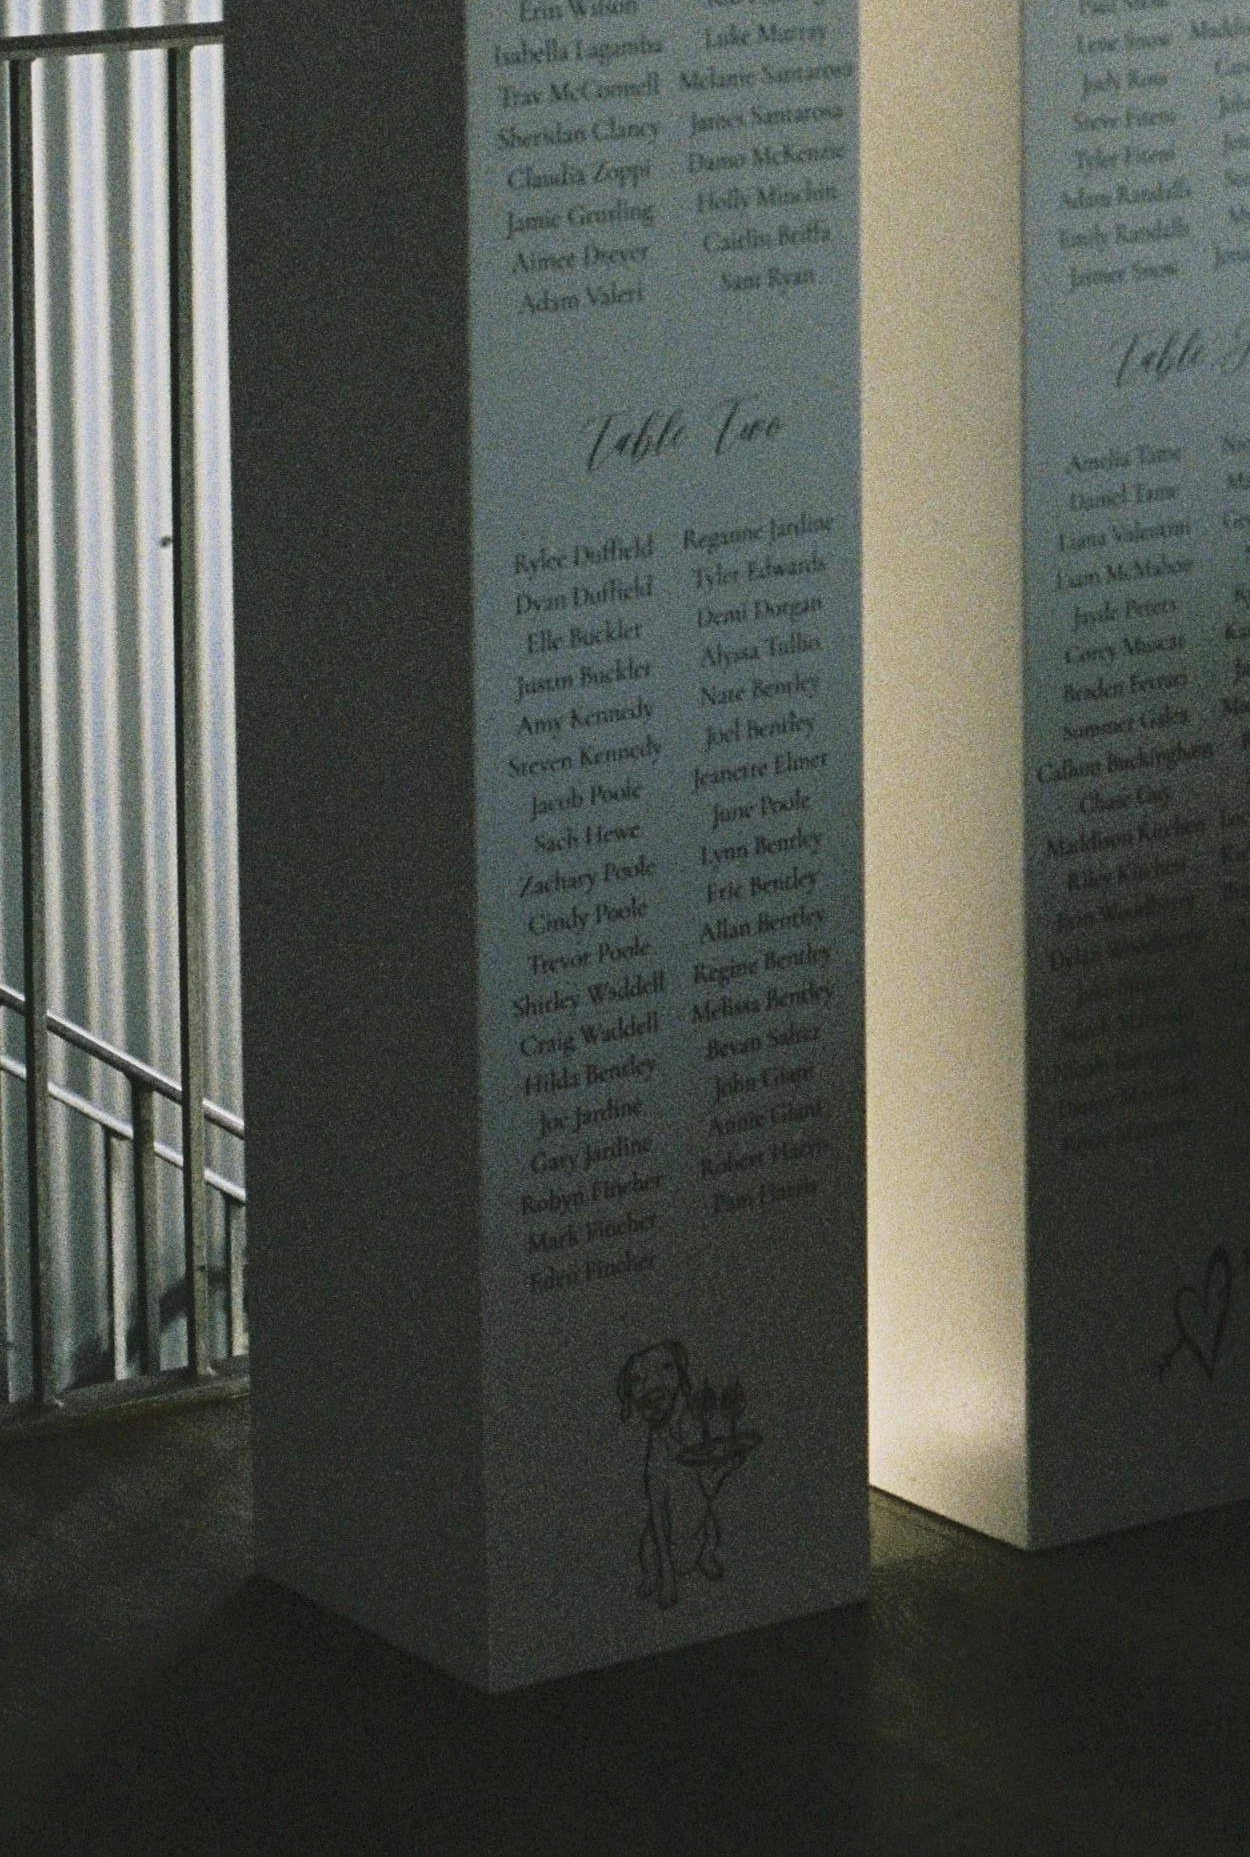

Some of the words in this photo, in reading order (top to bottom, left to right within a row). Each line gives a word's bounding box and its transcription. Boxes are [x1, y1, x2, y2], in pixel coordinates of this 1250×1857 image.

[1105, 327, 1205, 388] Table
[580, 407, 689, 473] Table
[708, 393, 783, 456] Two
